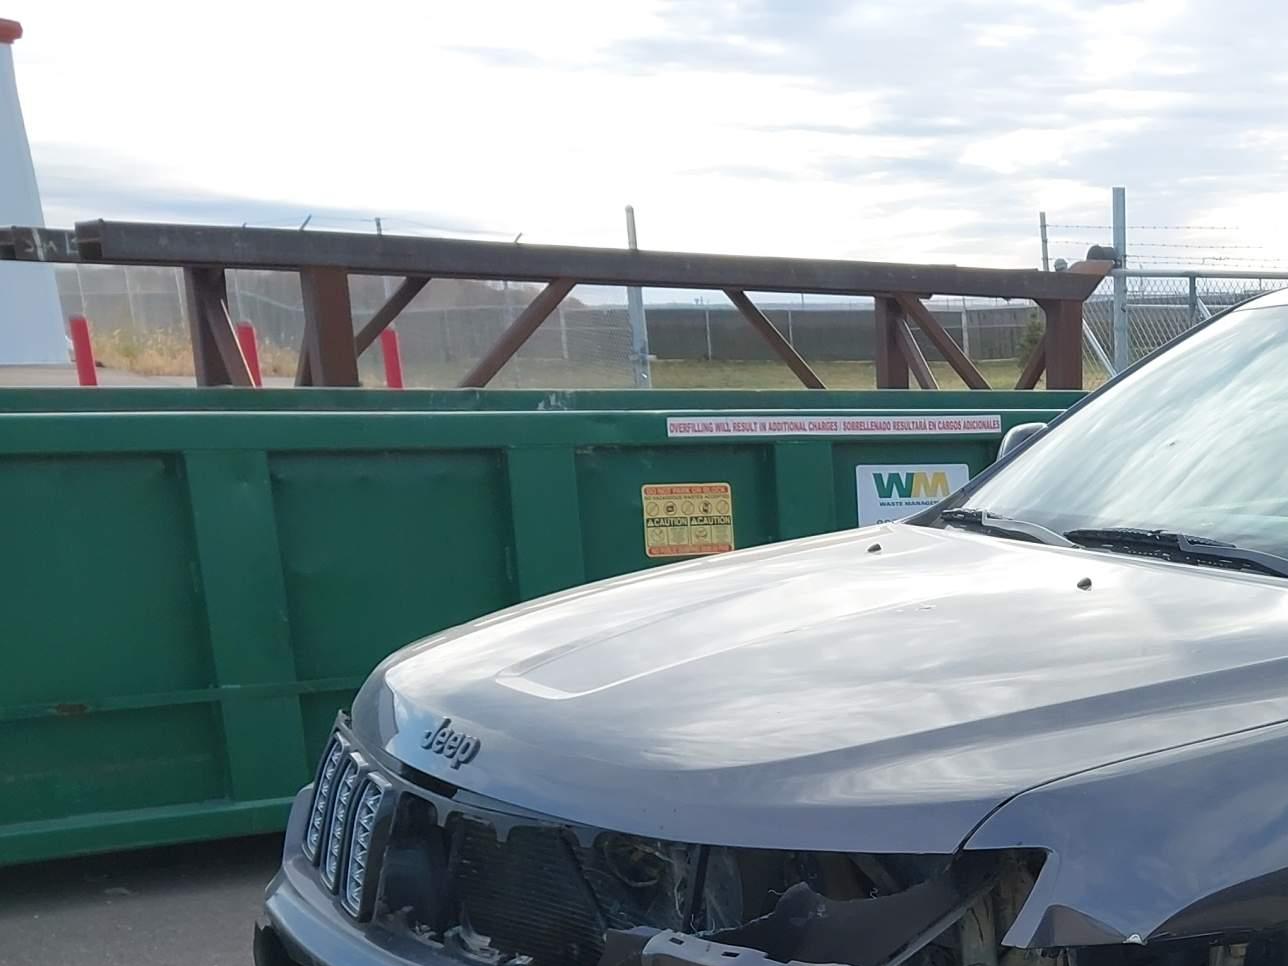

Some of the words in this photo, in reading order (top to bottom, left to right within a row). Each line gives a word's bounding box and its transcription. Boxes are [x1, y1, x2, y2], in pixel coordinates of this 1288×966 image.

[670, 422, 713, 433] OVERFILLING
[715, 422, 731, 432] WILL
[733, 422, 757, 432] RESULT
[759, 422, 767, 432] IN
[768, 421, 807, 432] ADDITIONAL
[808, 421, 838, 431] CHARGES
[928, 420, 937, 430] EN
[937, 420, 962, 430] CARGOS
[962, 419, 1000, 430] ADICIONALES
[872, 472, 950, 498] WM
[654, 518, 688, 526] CAUTION
[697, 516, 731, 525] CAUTION
[421, 718, 481, 770] Jeep
